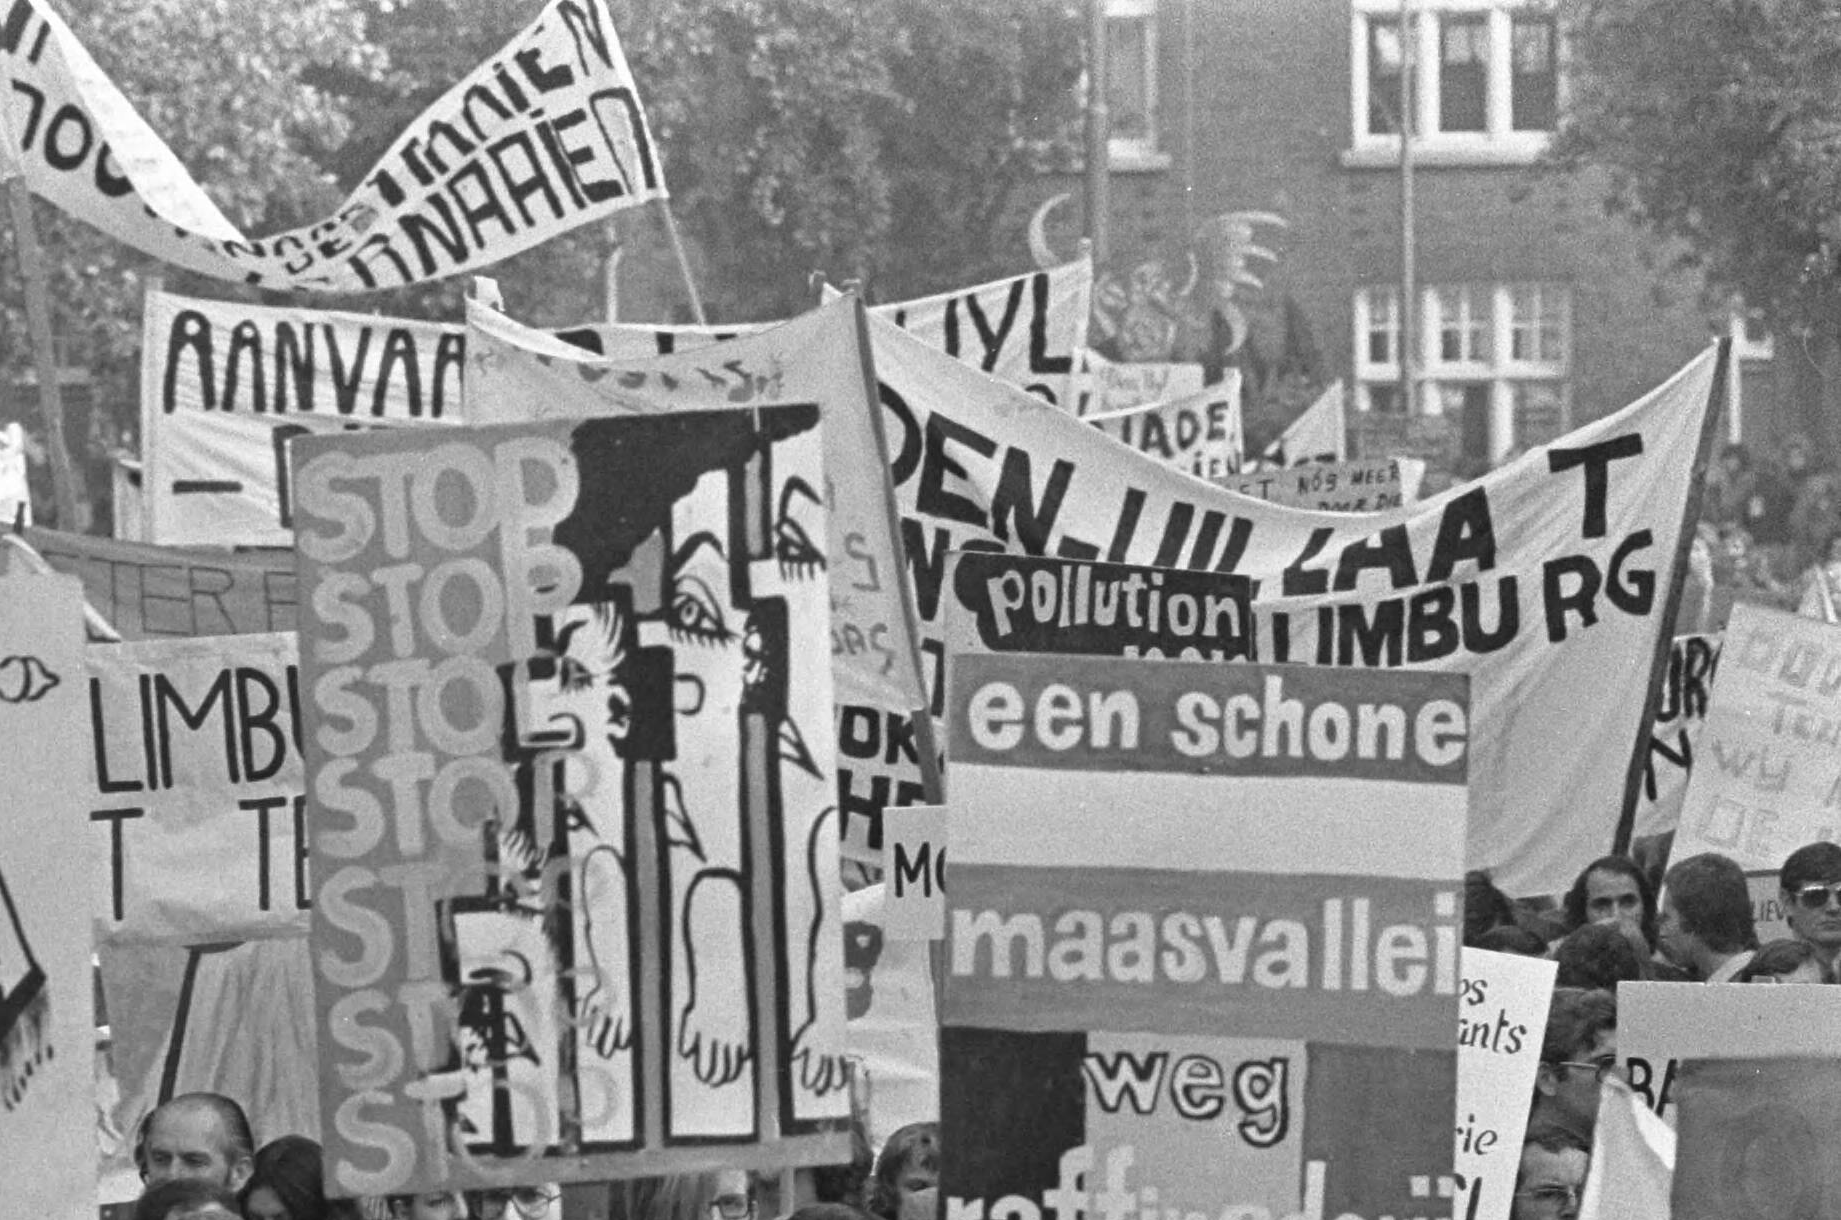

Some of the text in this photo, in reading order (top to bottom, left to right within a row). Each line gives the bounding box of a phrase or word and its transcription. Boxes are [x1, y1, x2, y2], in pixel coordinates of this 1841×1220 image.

[295, 436, 580, 562] STOP
[311, 543, 583, 664] STOP
[986, 563, 1242, 637] pollution
[1272, 530, 1655, 668] LIMBURG
[968, 674, 1467, 767] een schone
[951, 891, 1457, 996] maasvallei
[1082, 1051, 1292, 1148] weg
